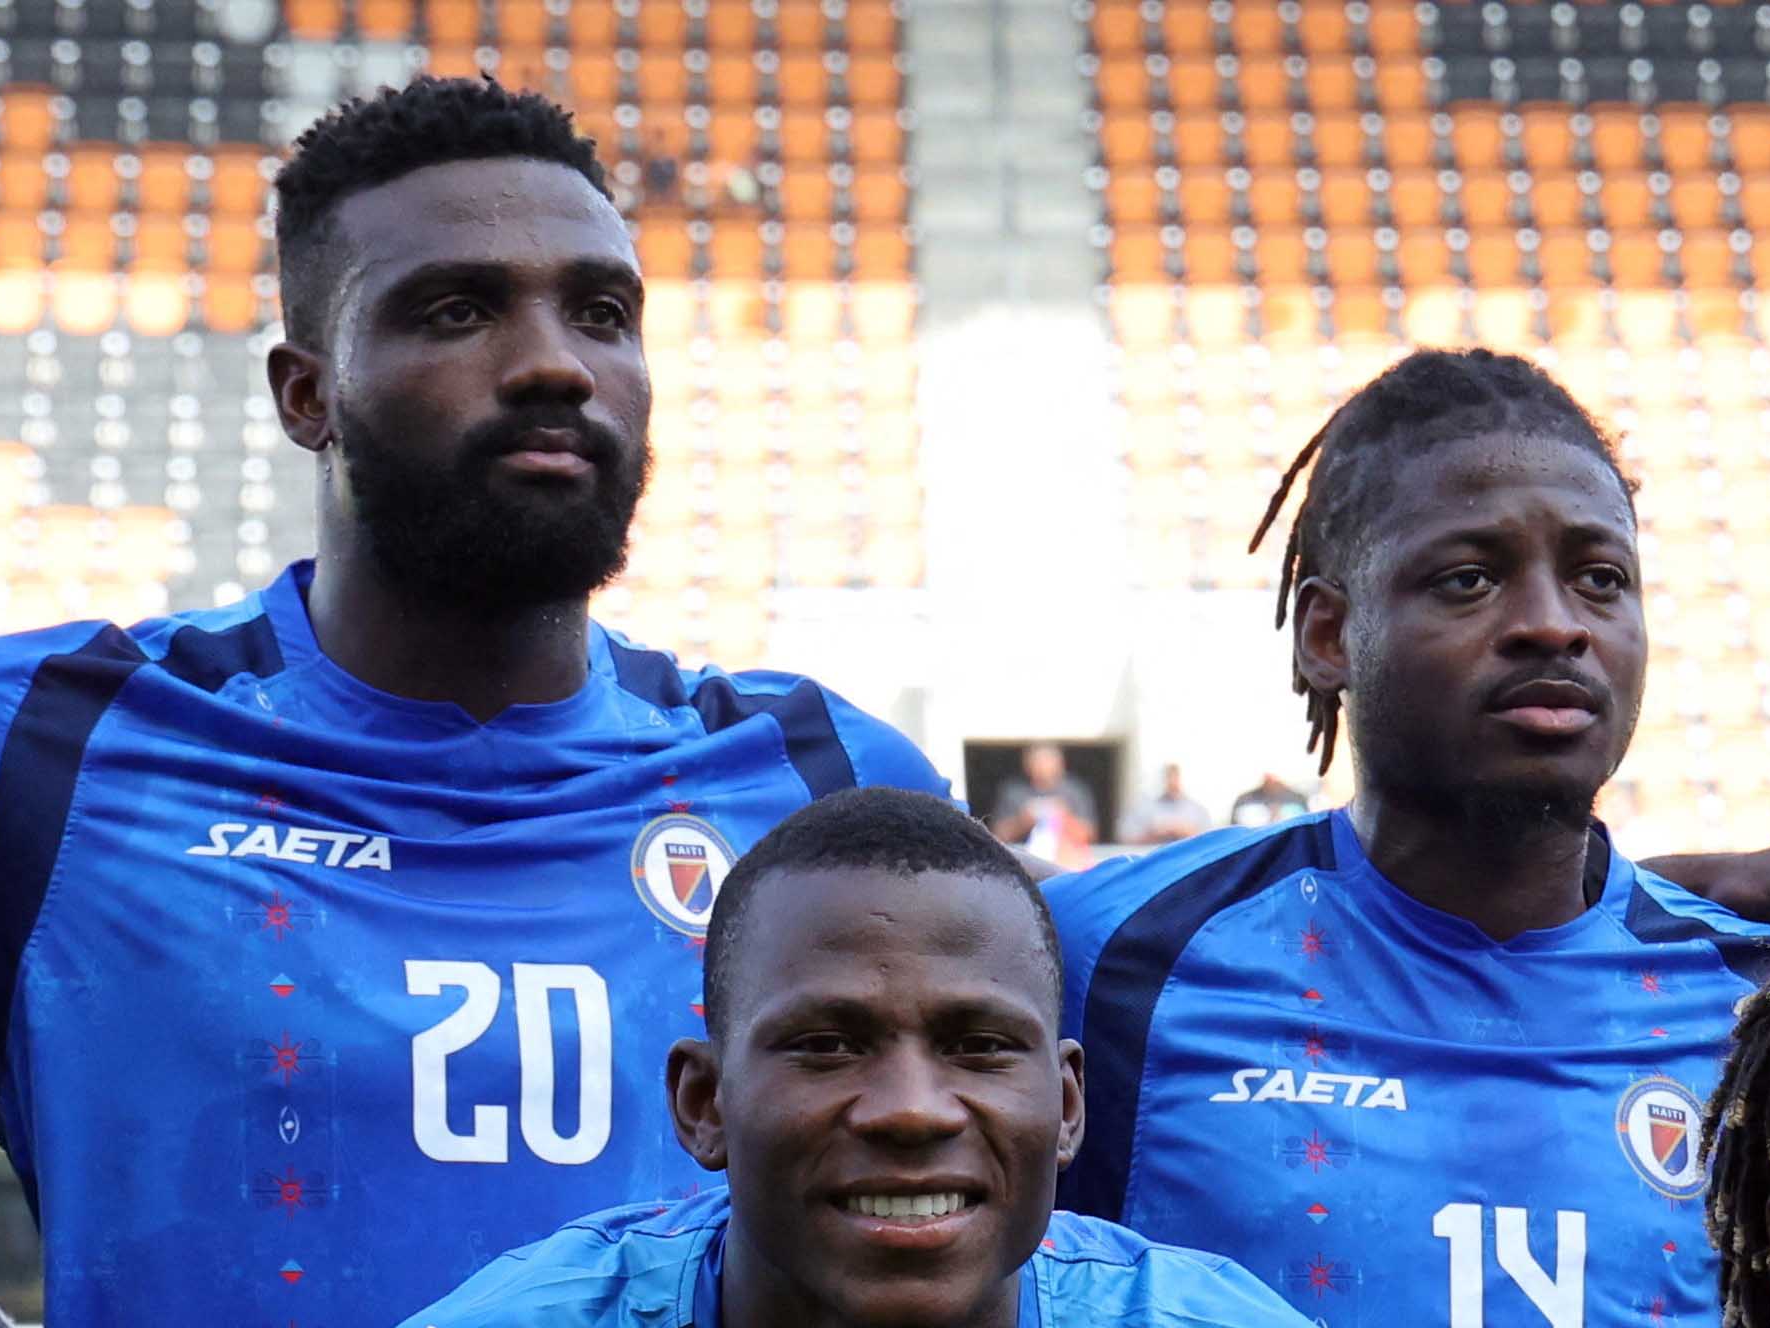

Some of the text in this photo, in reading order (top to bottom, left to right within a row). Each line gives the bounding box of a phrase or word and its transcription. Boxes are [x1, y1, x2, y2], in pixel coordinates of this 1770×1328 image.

[186, 823, 392, 871] SAETA
[403, 960, 612, 1165] 20
[1209, 1068, 1407, 1112] SAETA
